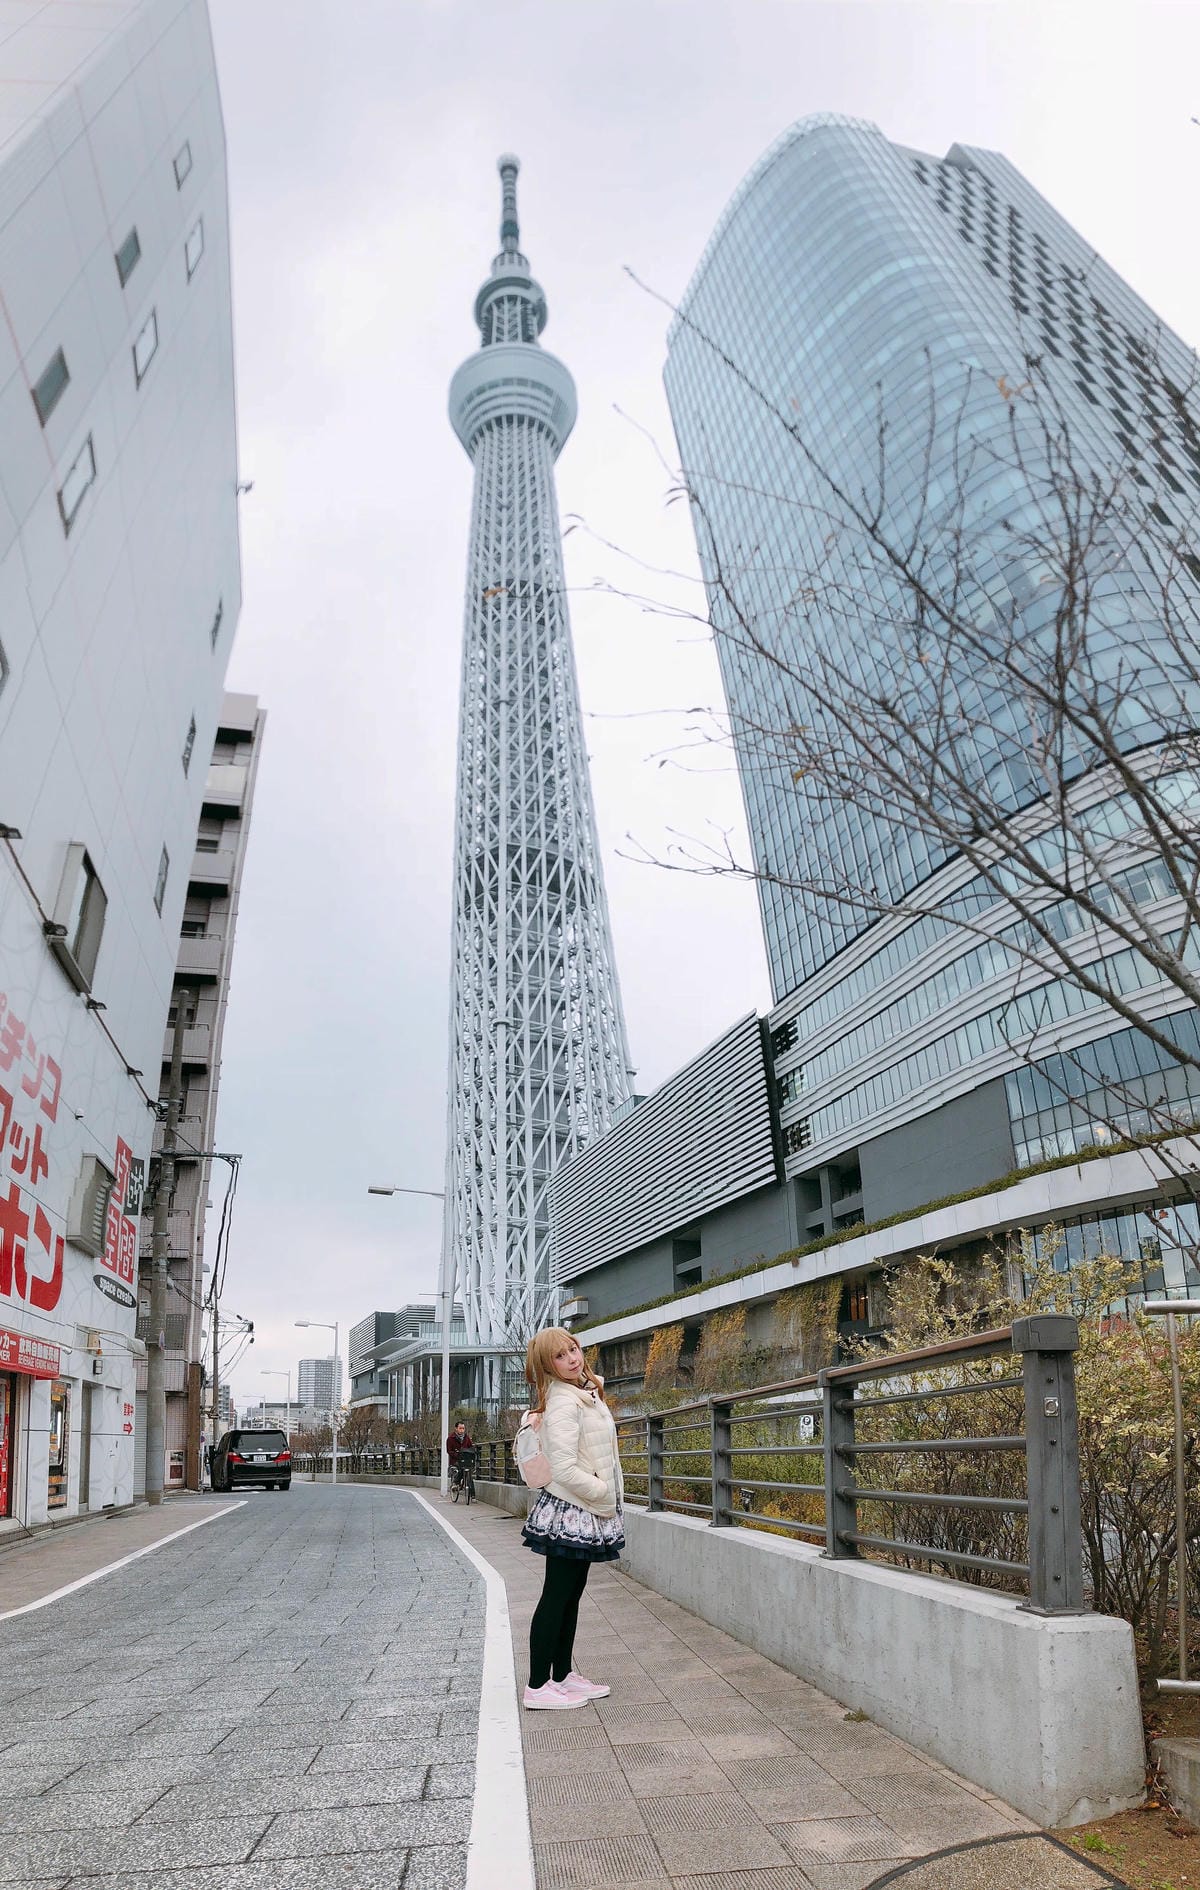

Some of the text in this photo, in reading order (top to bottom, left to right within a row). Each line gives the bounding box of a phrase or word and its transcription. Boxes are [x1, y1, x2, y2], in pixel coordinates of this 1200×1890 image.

[0, 993, 62, 1124] チンコ
[99, 1277, 117, 1296] space
